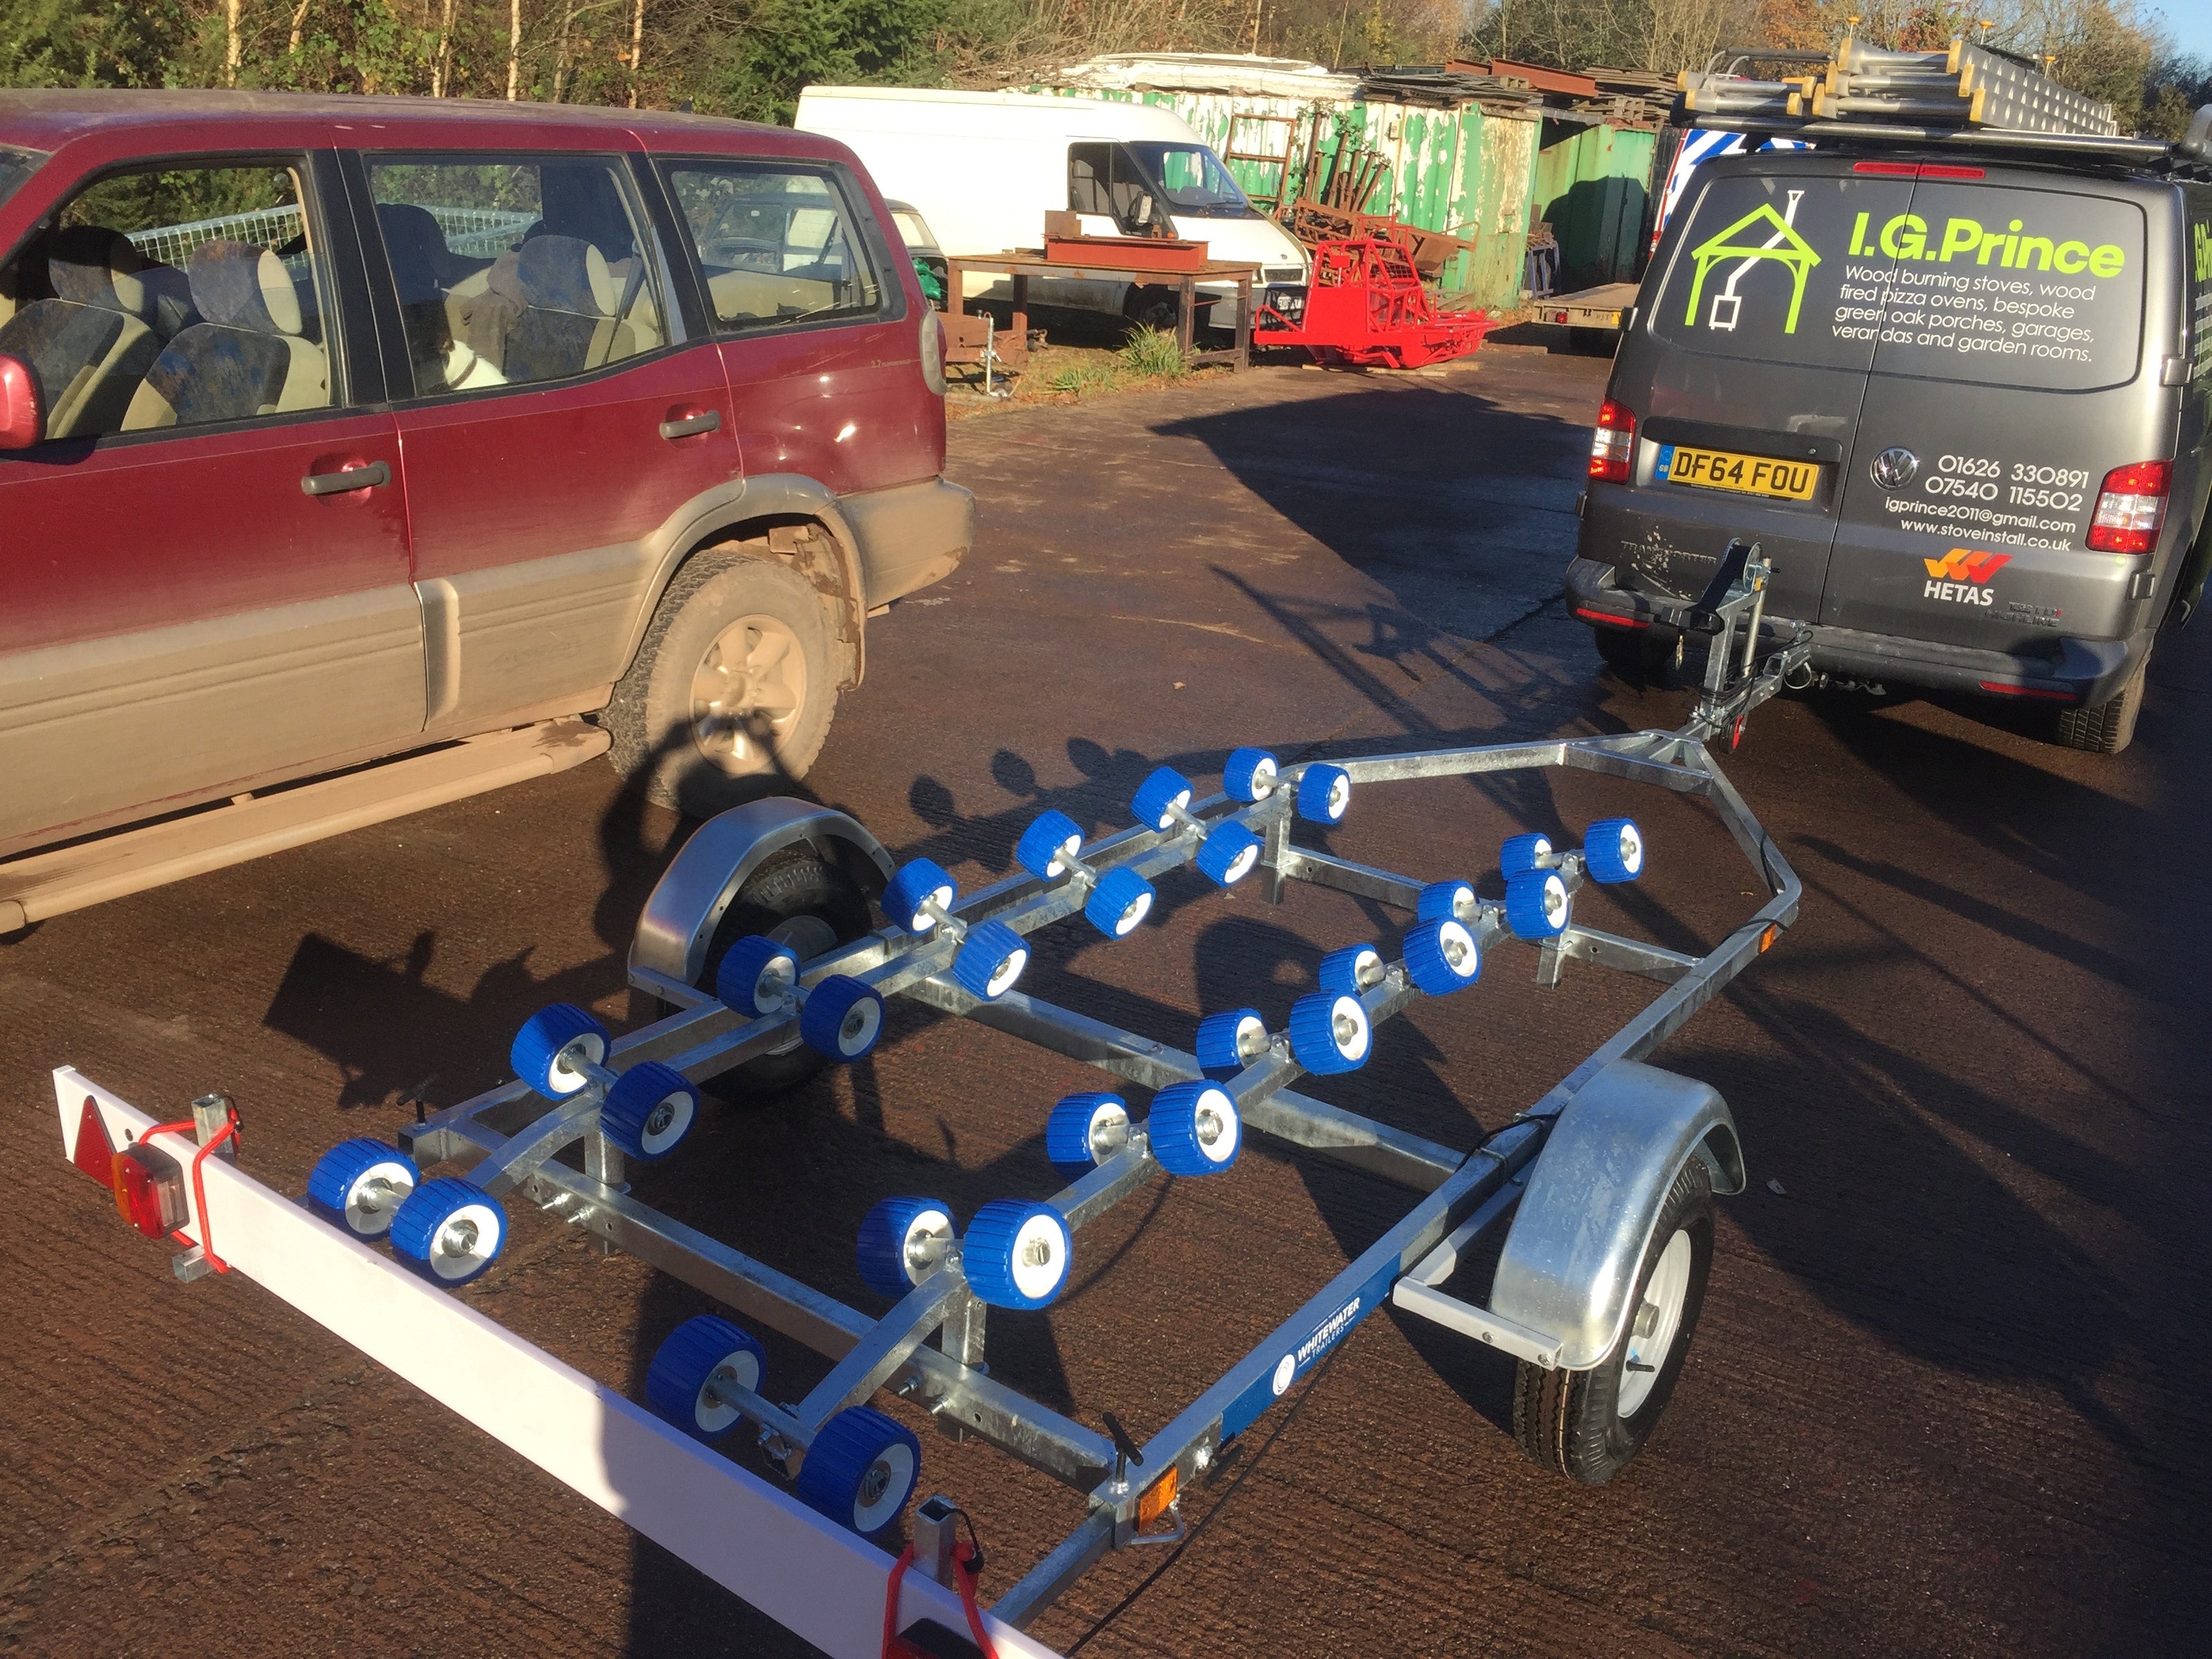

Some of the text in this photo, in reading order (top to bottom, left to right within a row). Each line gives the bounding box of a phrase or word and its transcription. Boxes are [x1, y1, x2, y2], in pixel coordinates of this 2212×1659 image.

[1848, 212, 2125, 278] I.G.Prince
[1846, 265, 2096, 301] Wood burning stoves, wood
[1840, 284, 2074, 319] fired pizza ovens, bespoke
[1832, 324, 2092, 362] verandas and garden rooms.
[1835, 306, 2094, 344] green oak porches, garages,
[1674, 451, 1745, 485] DF64
[1938, 454, 2089, 489] 01626 330891
[1925, 476, 2083, 512] 07540 115502
[1885, 496, 2076, 533] igprince2011@gmail.com
[1901, 519, 2072, 552] www.stoveinstall.co.uk
[1924, 579, 1994, 606] HETAS
[1297, 1297, 1360, 1362] WHITEWATER
[1312, 1324, 1344, 1358] TRAILERS
